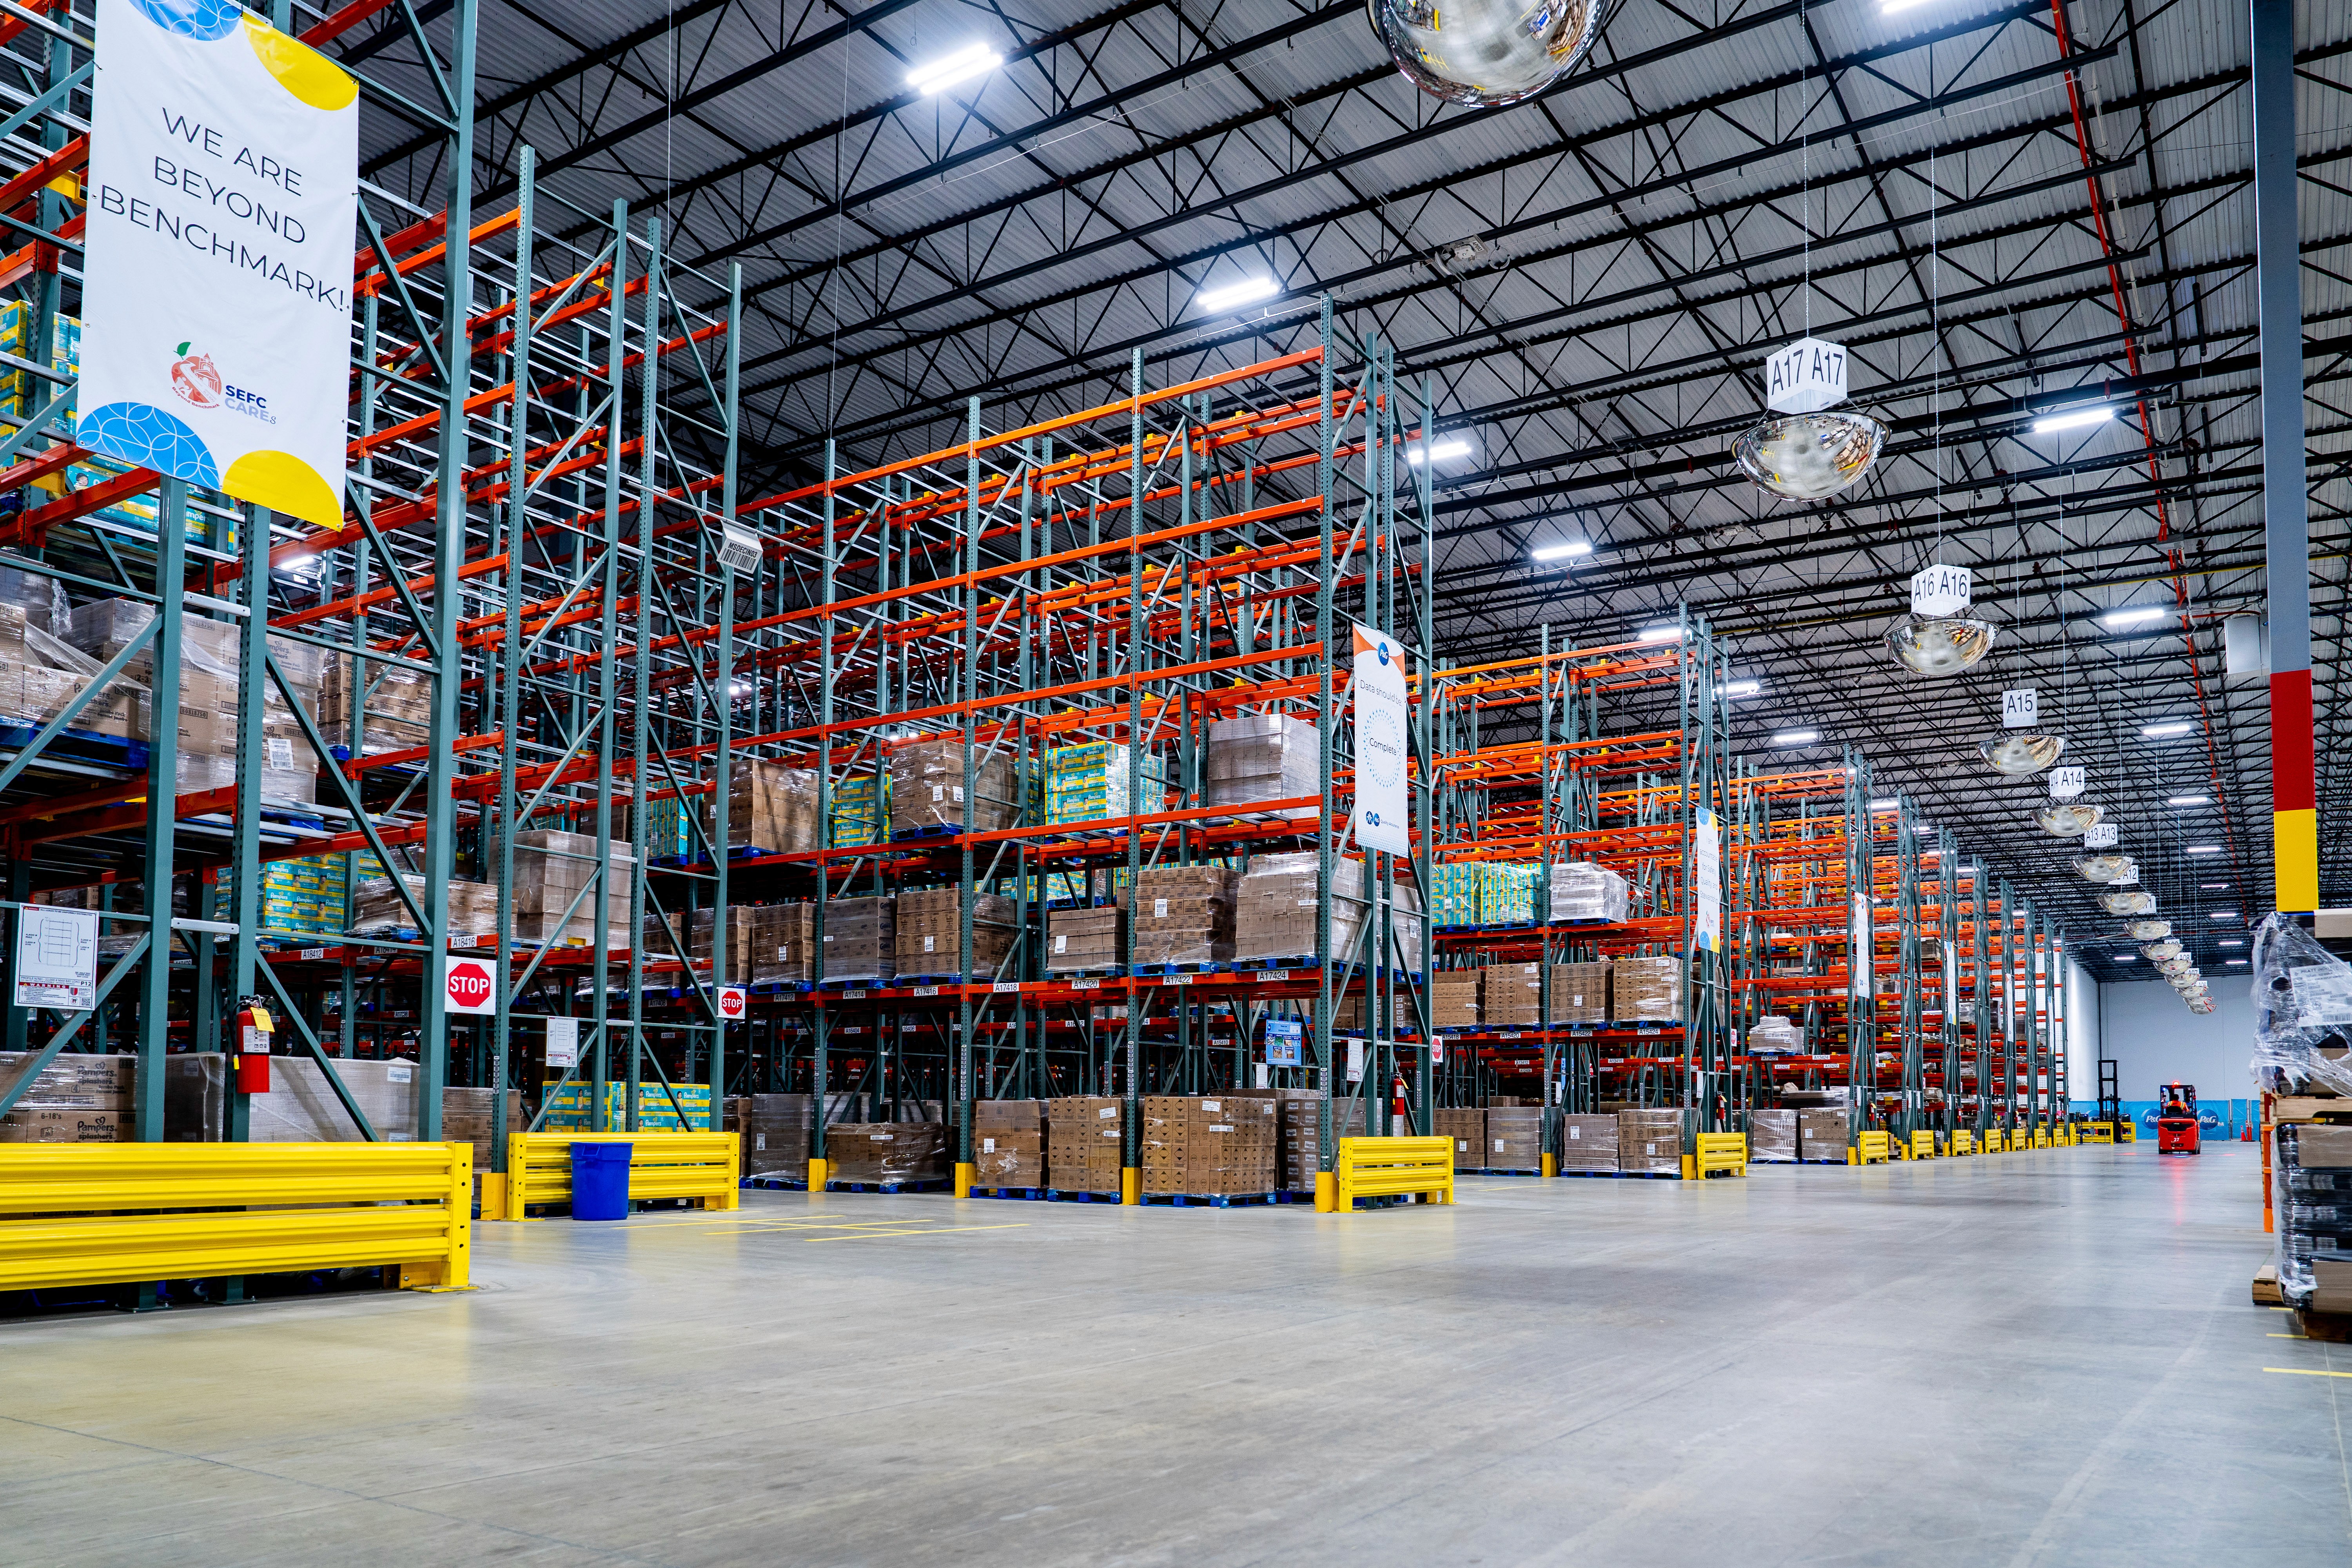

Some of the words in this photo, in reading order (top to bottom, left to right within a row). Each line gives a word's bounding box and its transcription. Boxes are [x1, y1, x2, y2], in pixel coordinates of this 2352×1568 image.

[162, 107, 222, 158] WE
[233, 147, 301, 196] ARE
[155, 156, 305, 243] BEYOND
[101, 185, 343, 312] BENCHMARK!
[1771, 349, 1804, 396] A17
[1812, 348, 1842, 385] A17
[172, 387, 190, 403] Beyond
[226, 385, 267, 408] SEFC
[1914, 573, 1934, 603] A16
[1940, 571, 1967, 597] A16
[1380, 649, 1388, 659] P&G
[1360, 679, 1375, 693] Data
[1376, 687, 1395, 702] should
[2007, 694, 2033, 713] A15
[182, 708, 207, 717] 80818750
[1370, 738, 1396, 756] Complete
[2062, 771, 2082, 786] A14
[2086, 829, 2098, 842] A13
[2101, 827, 2116, 840] A13
[453, 937, 475, 947] A18416
[303, 949, 322, 958] A18412
[1165, 975, 1190, 984] A17422
[1259, 971, 1286, 980] A17424
[450, 976, 489, 994] STOP
[995, 983, 1017, 992] A17418
[1074, 980, 1097, 989] A17420
[722, 998, 742, 1008] STOP
[77, 1065, 114, 1077] Pampers
[77, 1121, 114, 1132] Pampers
